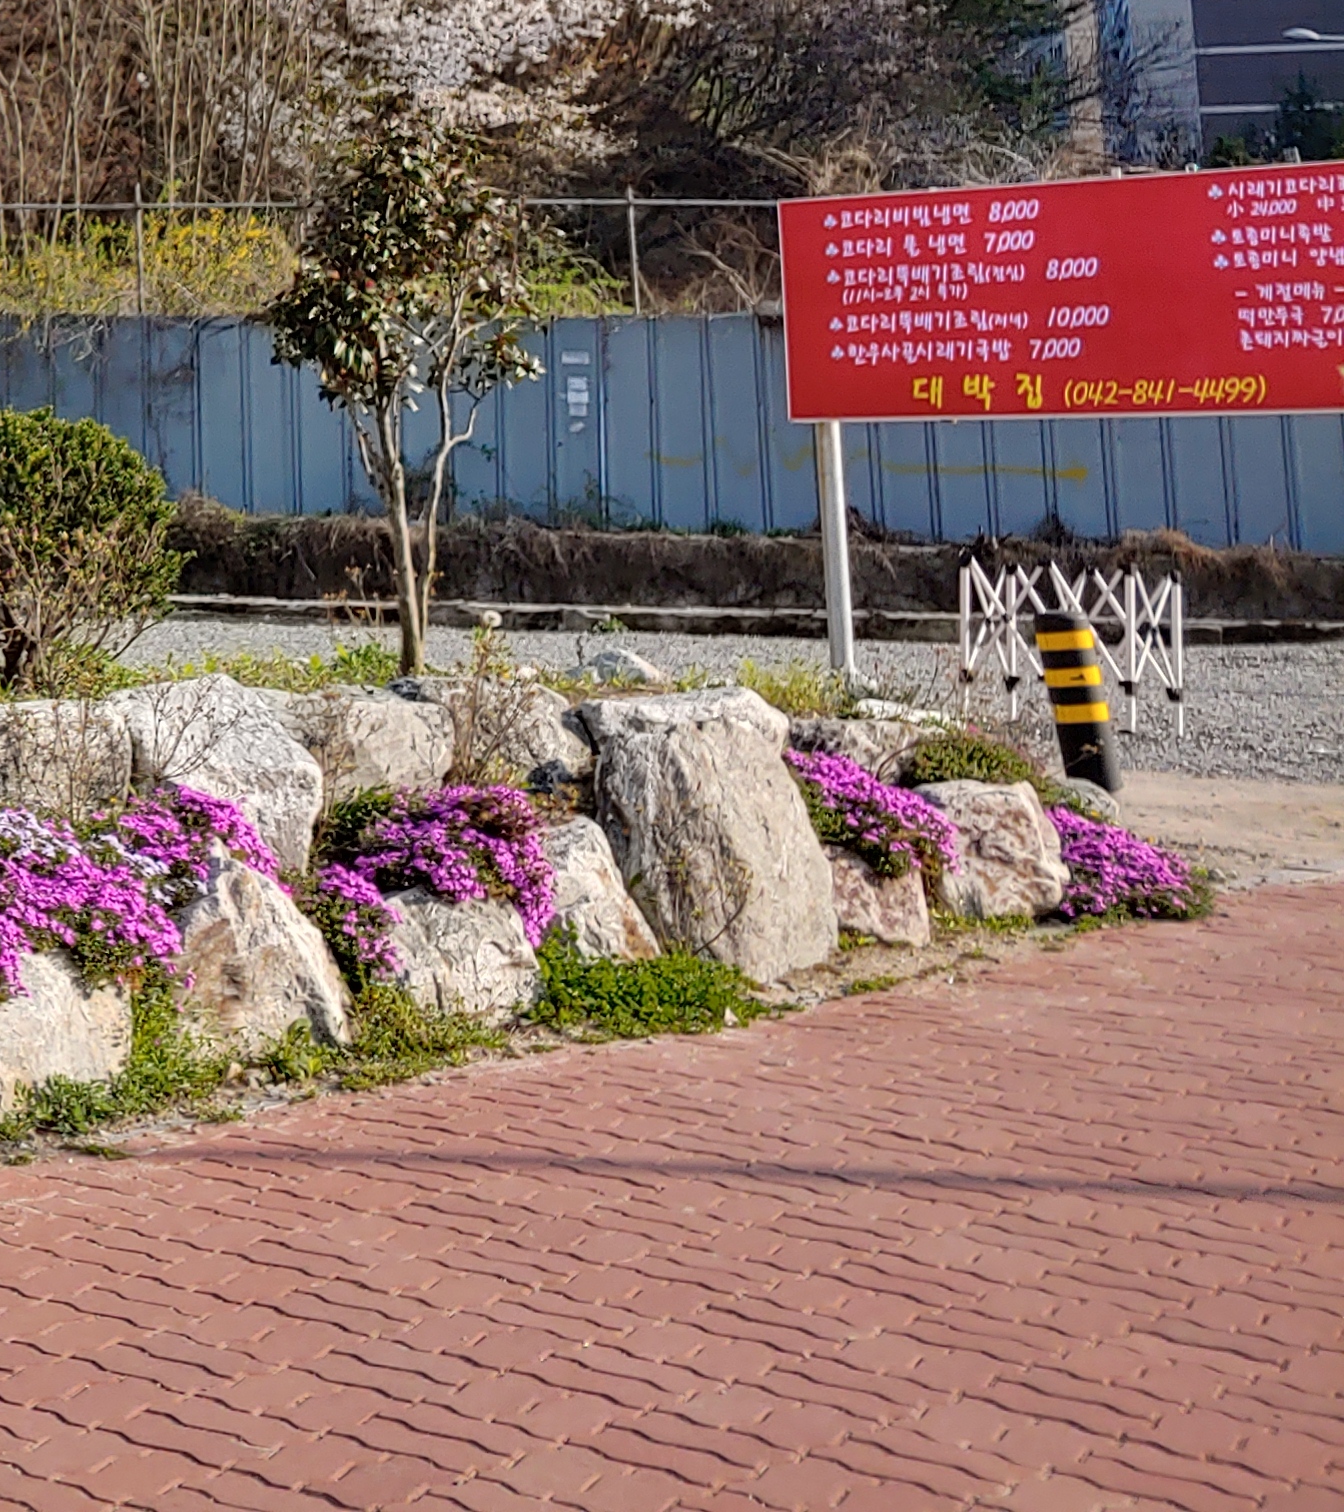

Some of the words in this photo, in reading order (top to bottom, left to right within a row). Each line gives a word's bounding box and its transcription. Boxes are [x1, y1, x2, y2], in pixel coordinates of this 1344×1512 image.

[988, 199, 1039, 223] 8,000
[1250, 198, 1297, 216] 24,000
[983, 229, 1034, 254] 7,000
[1046, 257, 1099, 281] 8,000
[1048, 305, 1110, 330] 10,000
[1029, 337, 1082, 361] 7,000
[1064, 374, 1267, 409] (042-841-4499)
